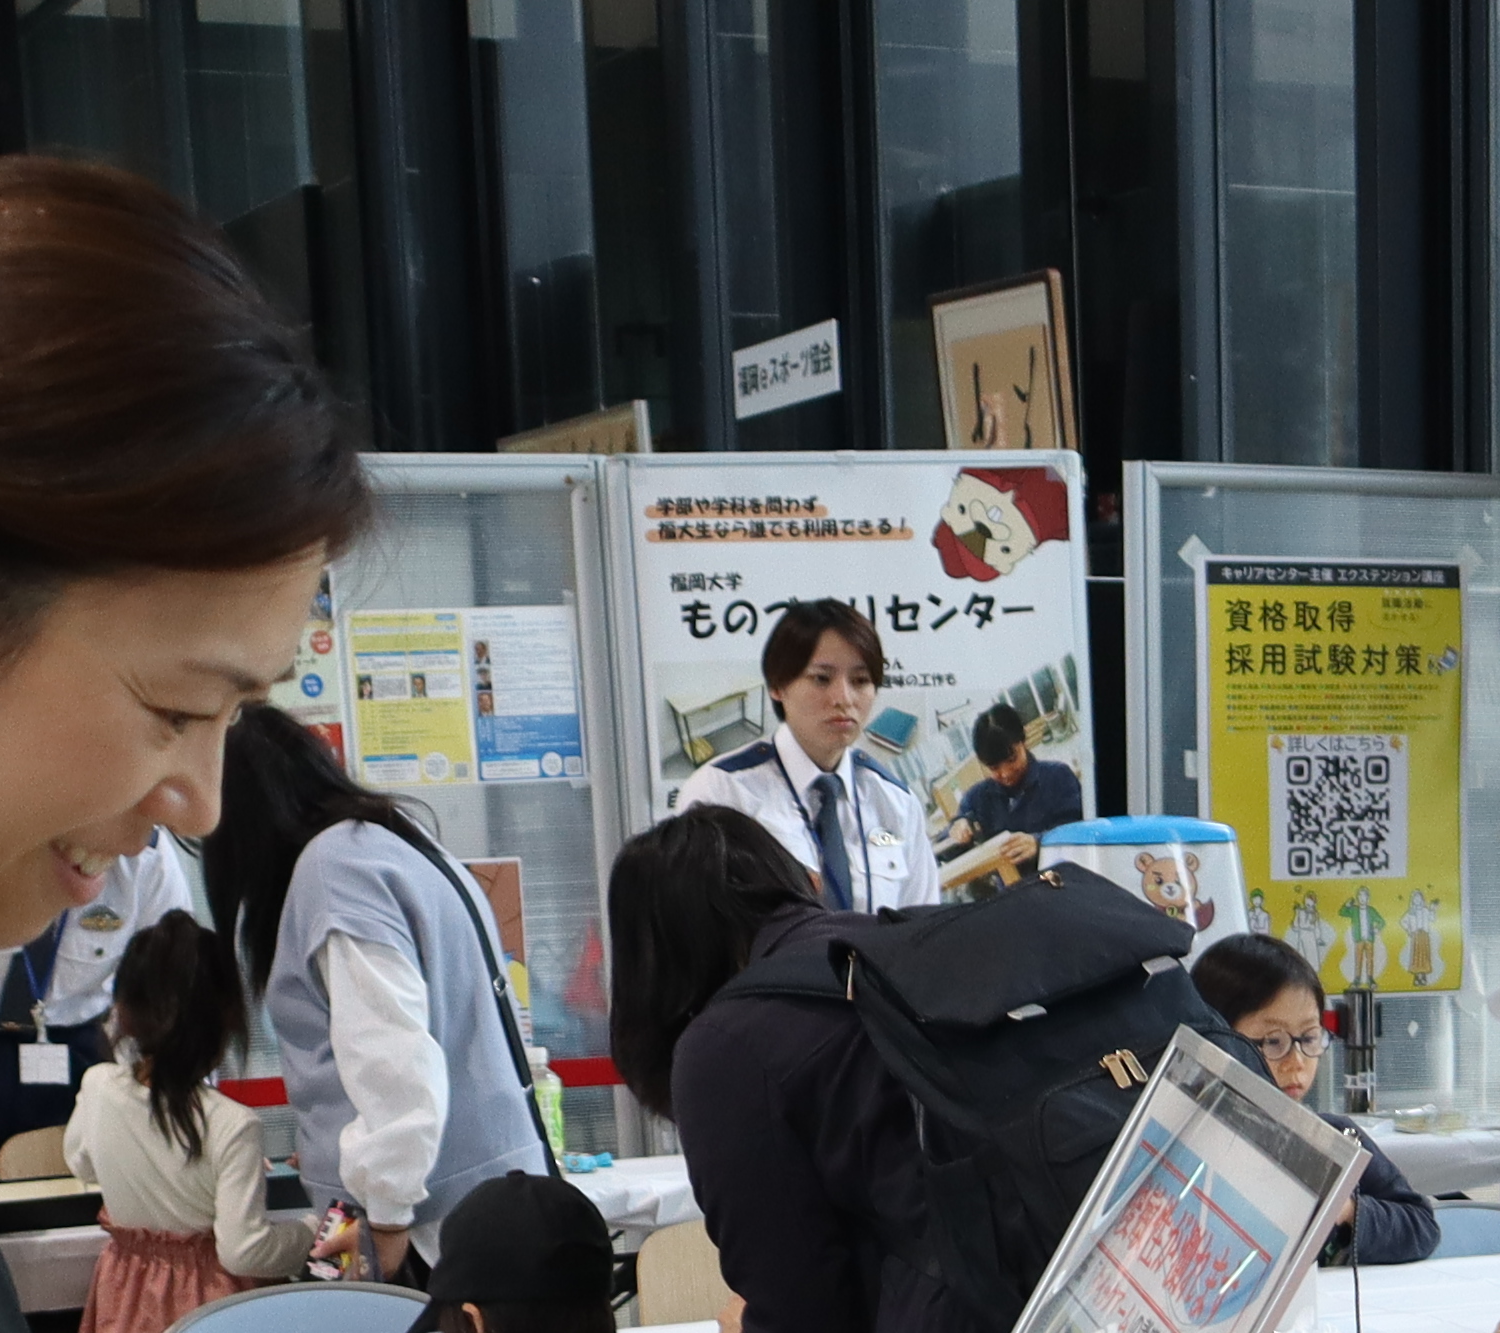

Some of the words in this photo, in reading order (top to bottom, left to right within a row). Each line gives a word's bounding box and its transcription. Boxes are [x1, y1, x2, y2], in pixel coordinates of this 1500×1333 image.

[737, 339, 834, 398] 福岡eスポーツ協会
[655, 496, 820, 517] 学部や学科を問わず
[668, 573, 744, 593] 福岡大学
[1337, 567, 1446, 585] エクステンション講座
[1224, 599, 1356, 633] 資格取得
[1224, 643, 1424, 677] 採用試験対策
[1286, 736, 1387, 753] 詳しくはこちら
